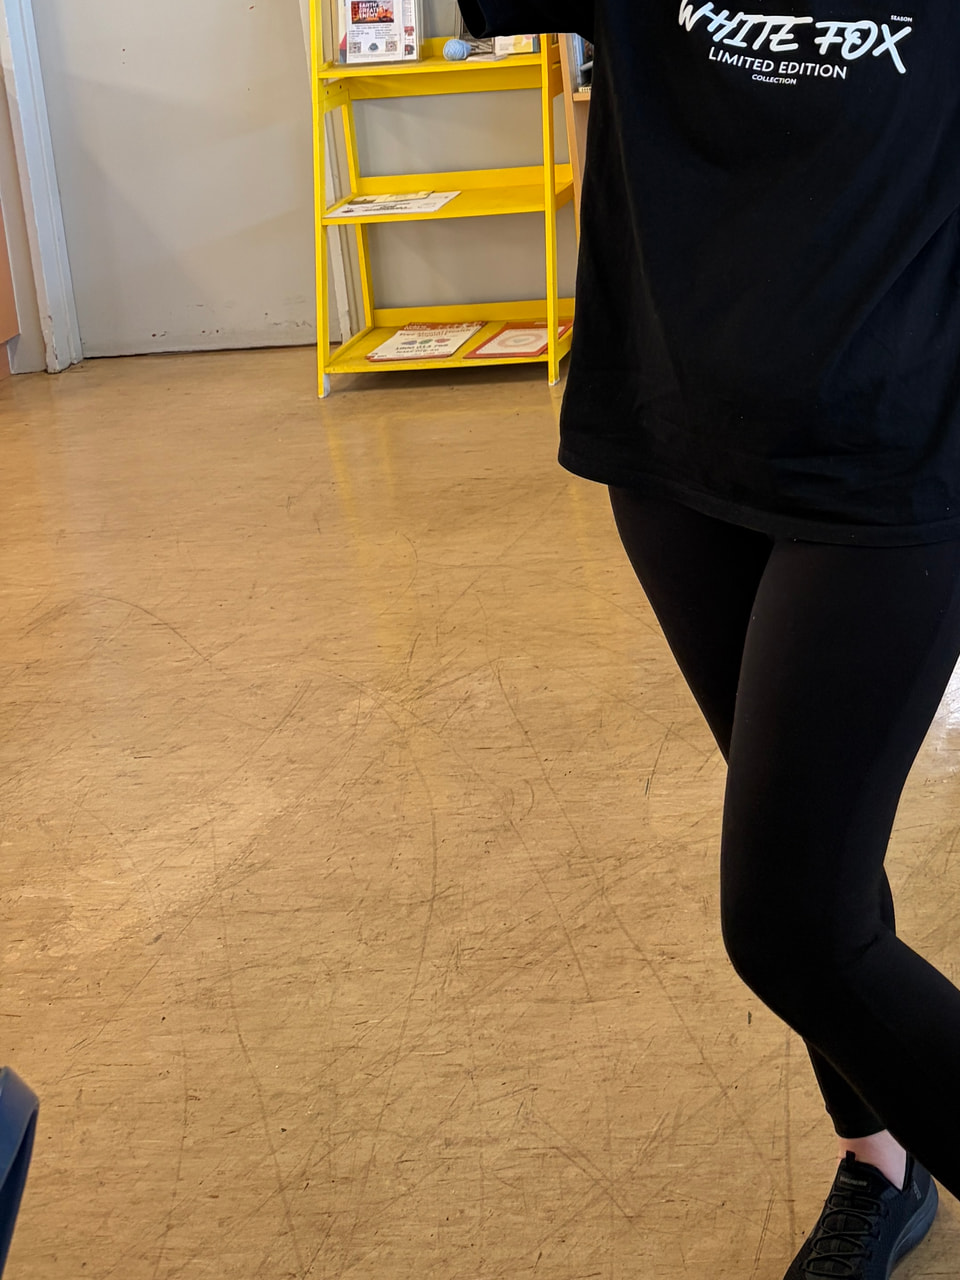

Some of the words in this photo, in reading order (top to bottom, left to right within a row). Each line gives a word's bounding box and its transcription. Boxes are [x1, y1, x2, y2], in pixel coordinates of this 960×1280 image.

[891, 15, 913, 23] SEASON
[814, 20, 912, 74] FOX
[708, 46, 775, 73] LIMITED
[778, 61, 847, 80] EDITION
[752, 74, 797, 86] COLLECTION
